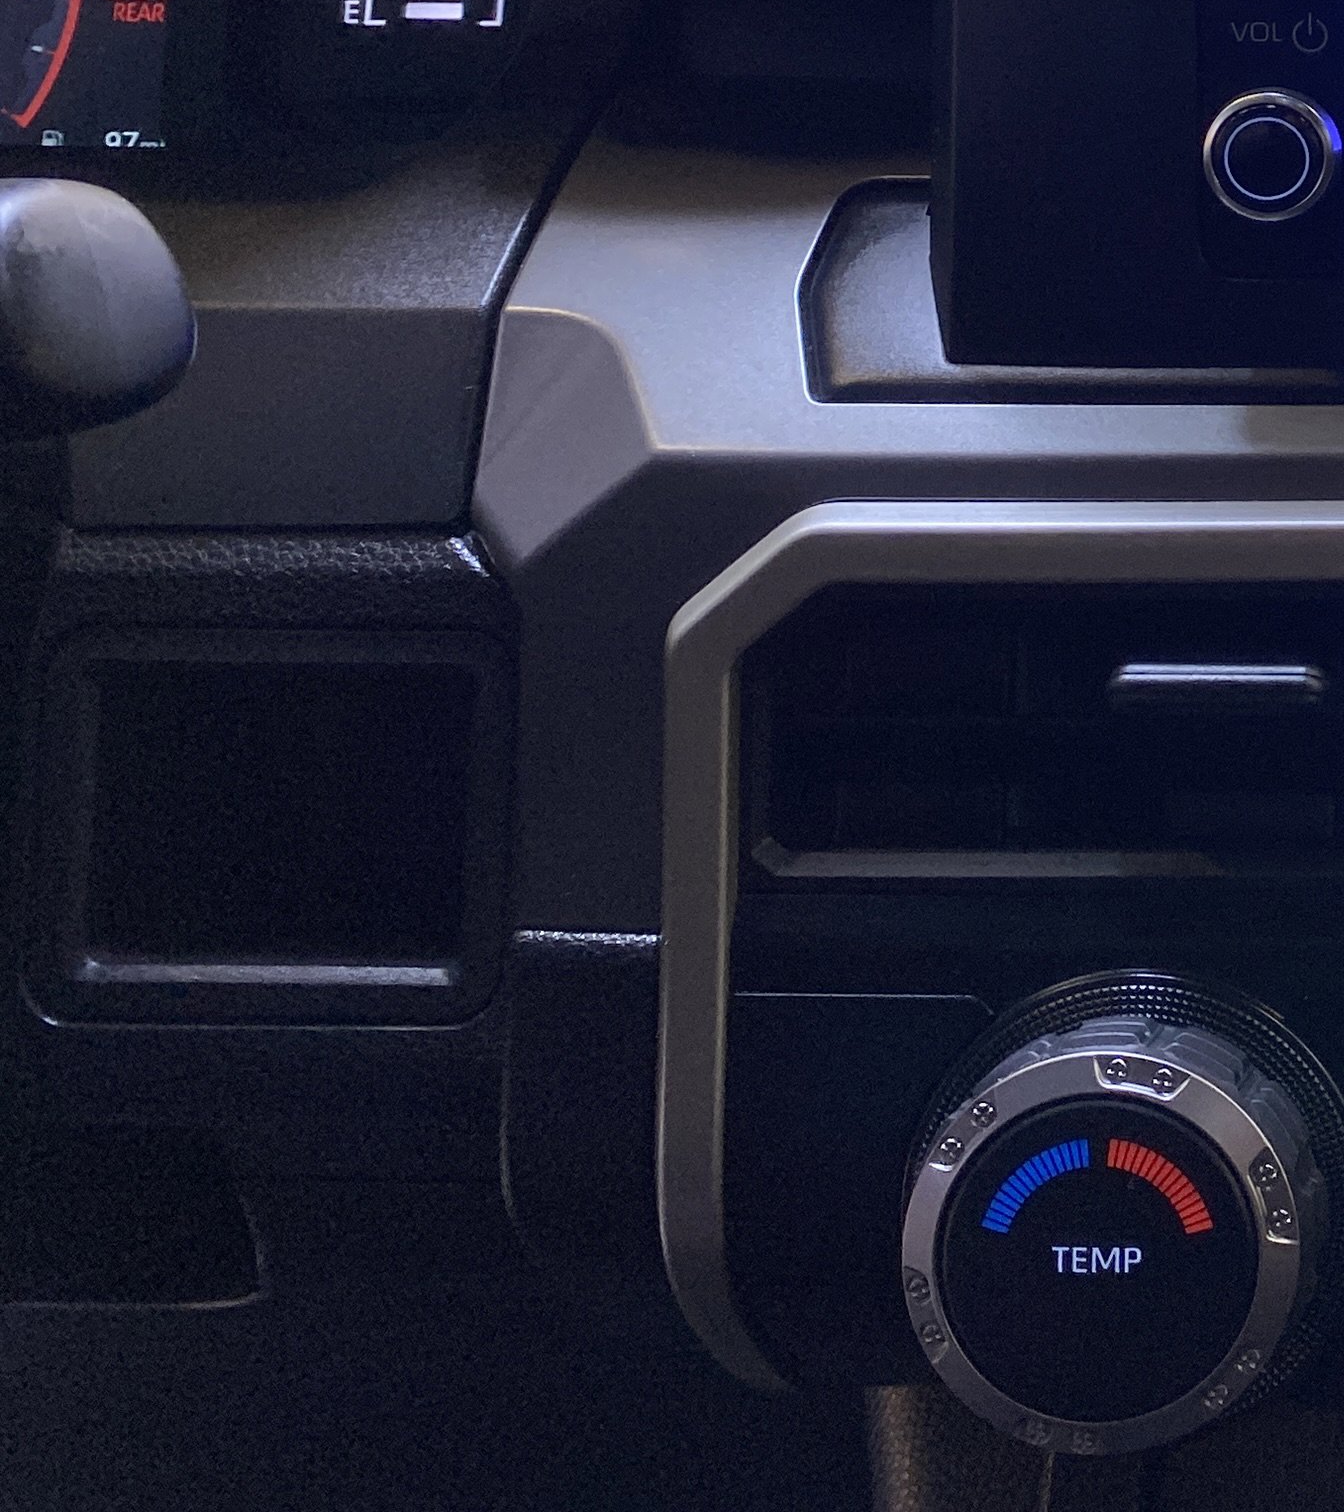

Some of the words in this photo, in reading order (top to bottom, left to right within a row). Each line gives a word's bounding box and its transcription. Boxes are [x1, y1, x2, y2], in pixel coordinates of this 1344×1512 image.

[112, 2, 166, 23] REAR
[344, 0, 361, 25] E
[1230, 21, 1283, 42] VOL
[1051, 1246, 1142, 1274] TEMP
